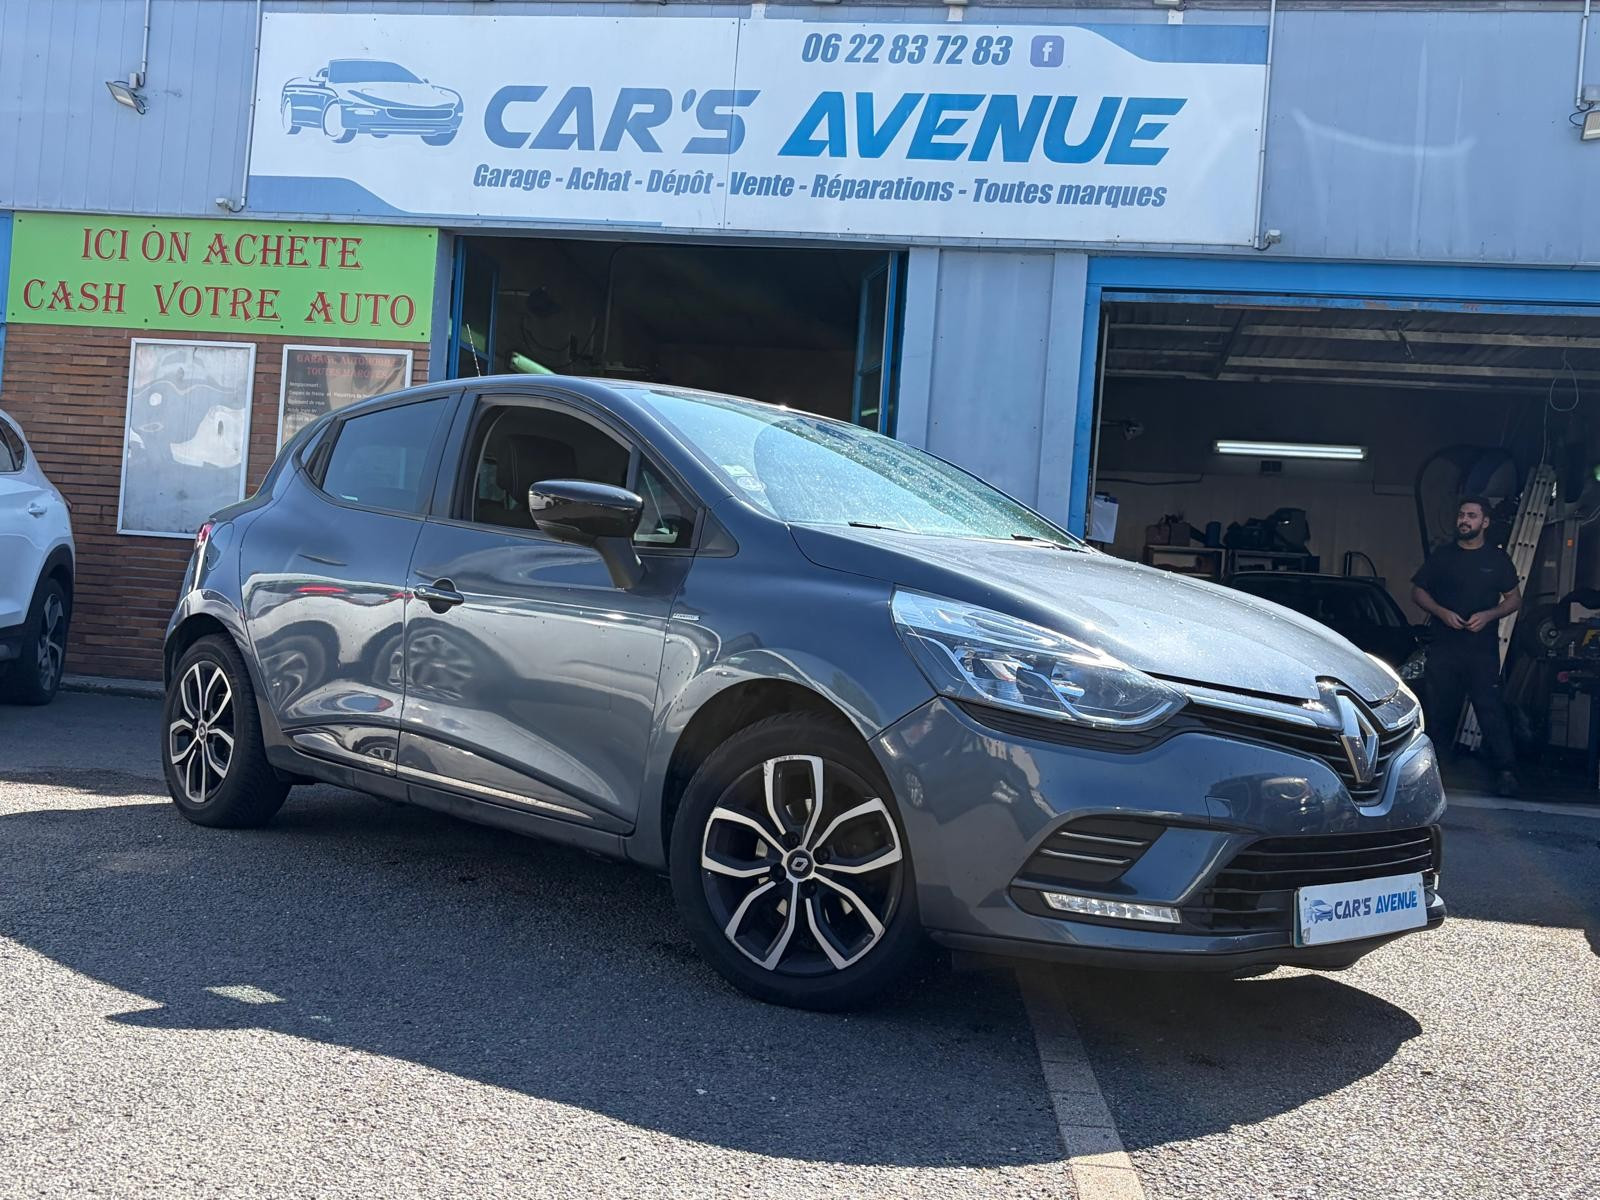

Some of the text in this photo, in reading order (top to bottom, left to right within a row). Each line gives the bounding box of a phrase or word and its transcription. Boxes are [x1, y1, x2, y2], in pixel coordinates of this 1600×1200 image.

[802, 33, 1013, 65] 06 22 83 72 83
[484, 86, 1188, 166] CAR'S AVENUE
[473, 164, 551, 191] Garage
[566, 167, 632, 191] Achat
[647, 169, 714, 196] Dépôt
[730, 172, 795, 197] Vente
[811, 174, 954, 201] Réparations
[973, 179, 1053, 204] Toutes
[1056, 185, 1167, 208] marques
[82, 228, 363, 269] ICI ON ACHETE
[24, 279, 416, 326] CASH VOTRE AUTO
[1334, 890, 1418, 920] CAR'S AVENUE
